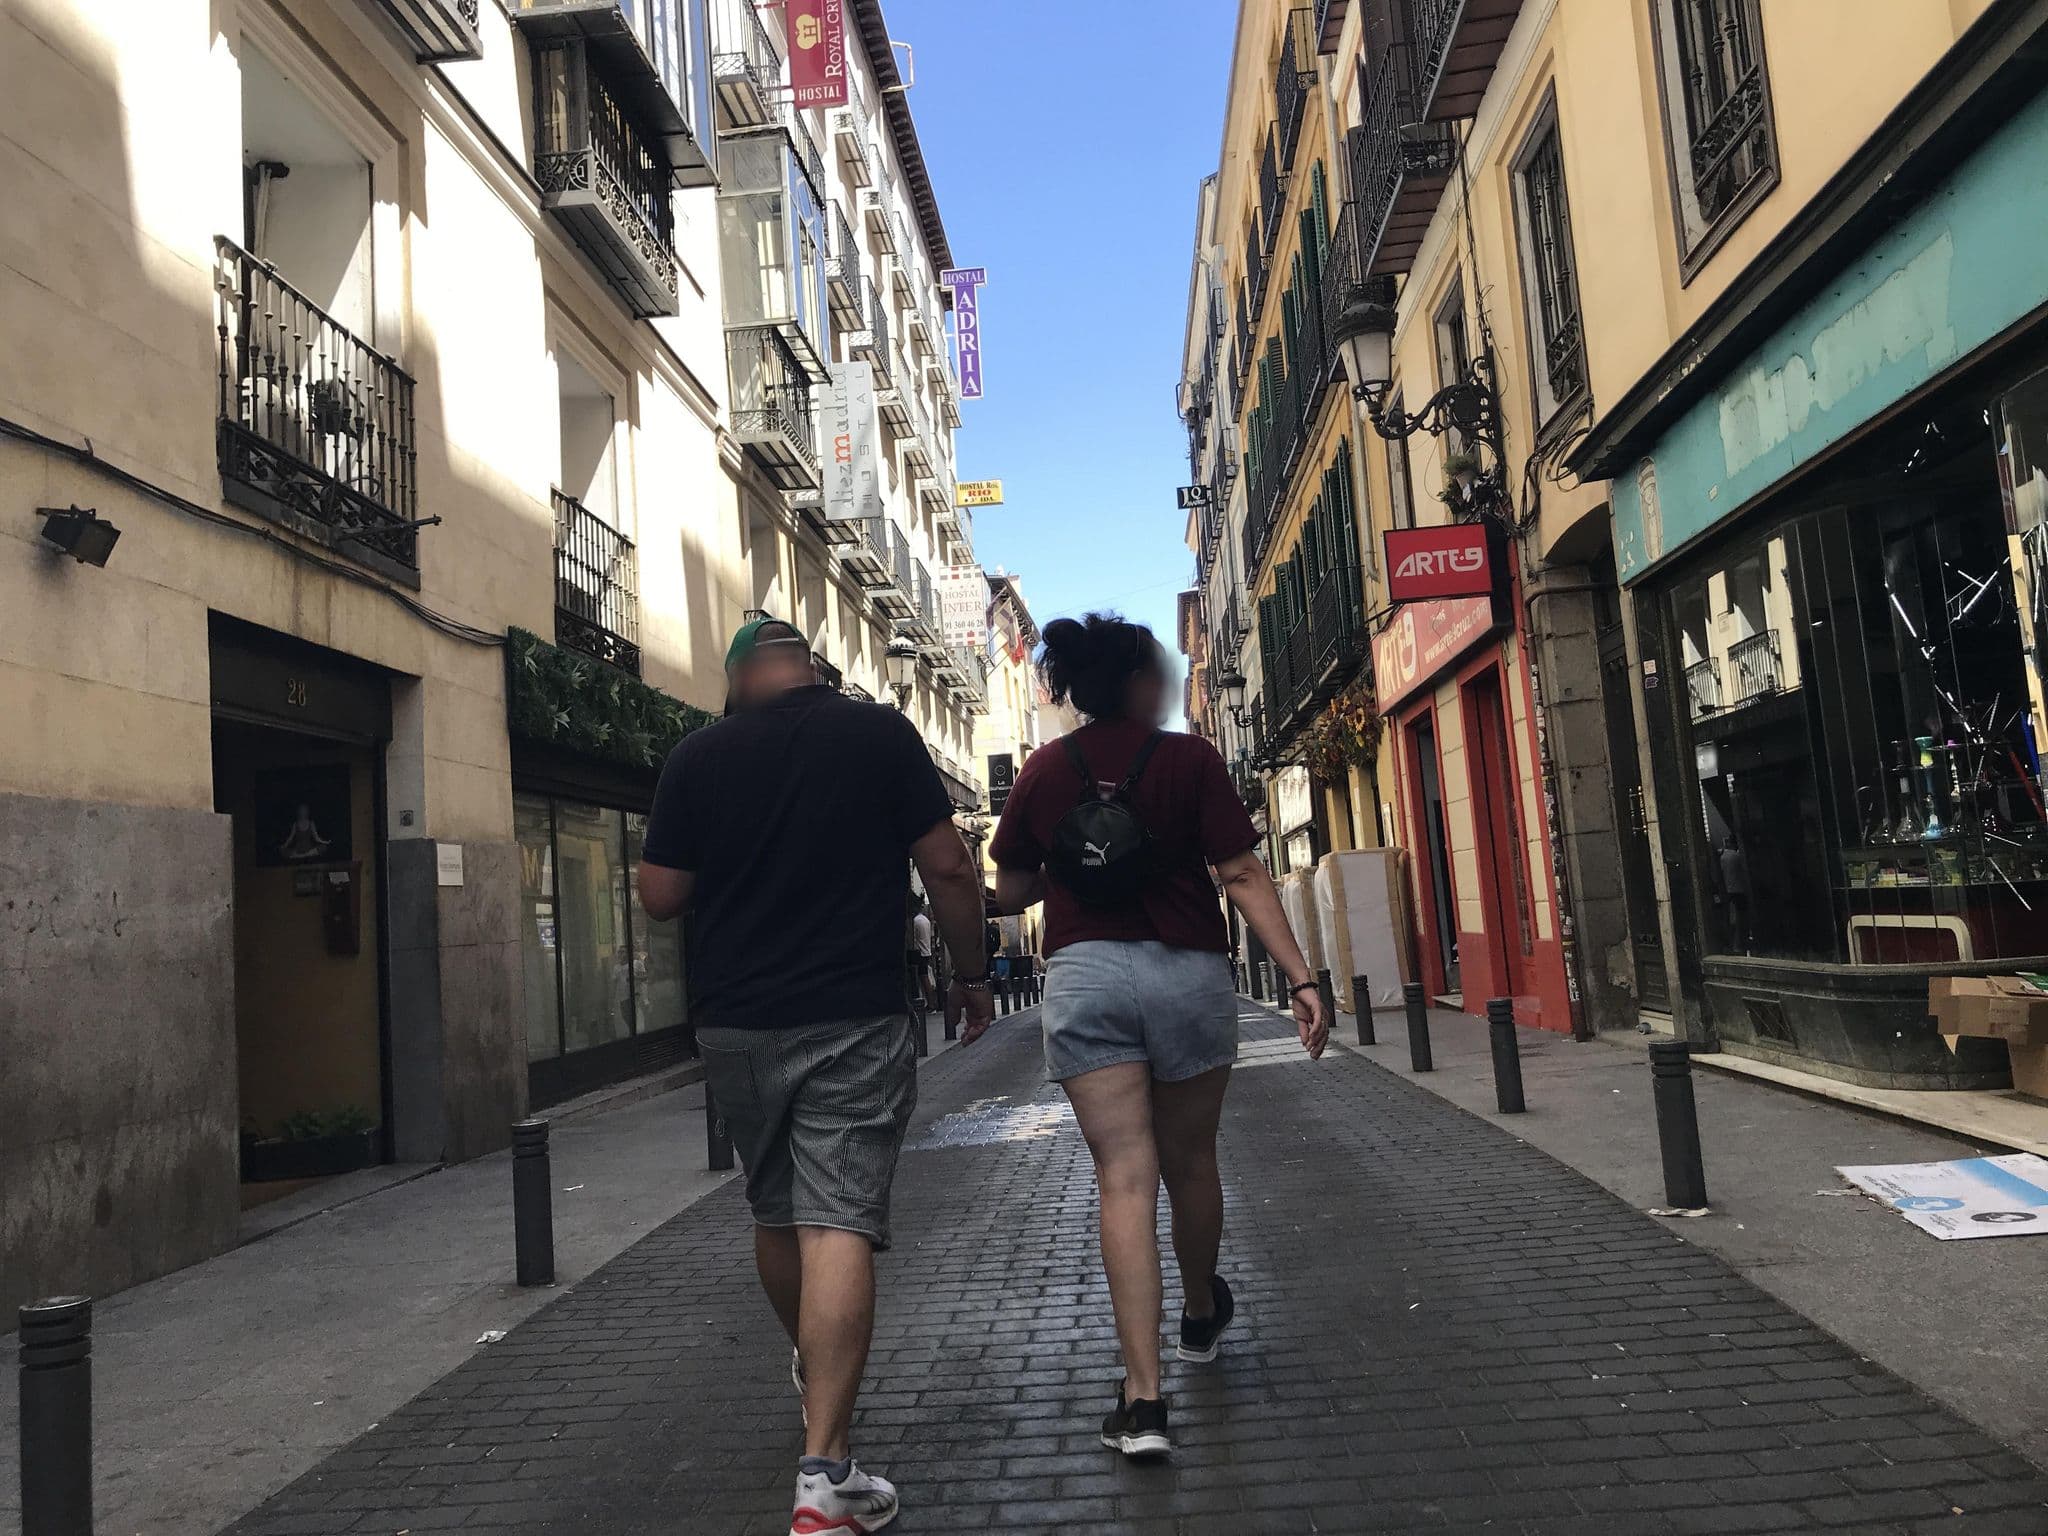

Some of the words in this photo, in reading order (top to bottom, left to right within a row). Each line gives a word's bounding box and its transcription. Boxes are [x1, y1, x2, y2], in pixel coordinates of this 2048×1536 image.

[826, 0, 839, 24] CR
[825, 26, 843, 78] ROYAL
[799, 85, 842, 101] HOSTAL
[943, 270, 984, 285] HOSTAL
[957, 290, 980, 394] ADRIA
[855, 369, 873, 509] HOSTAL
[968, 489, 992, 497] RIO
[944, 601, 983, 614] INTER
[287, 678, 306, 707] 28
